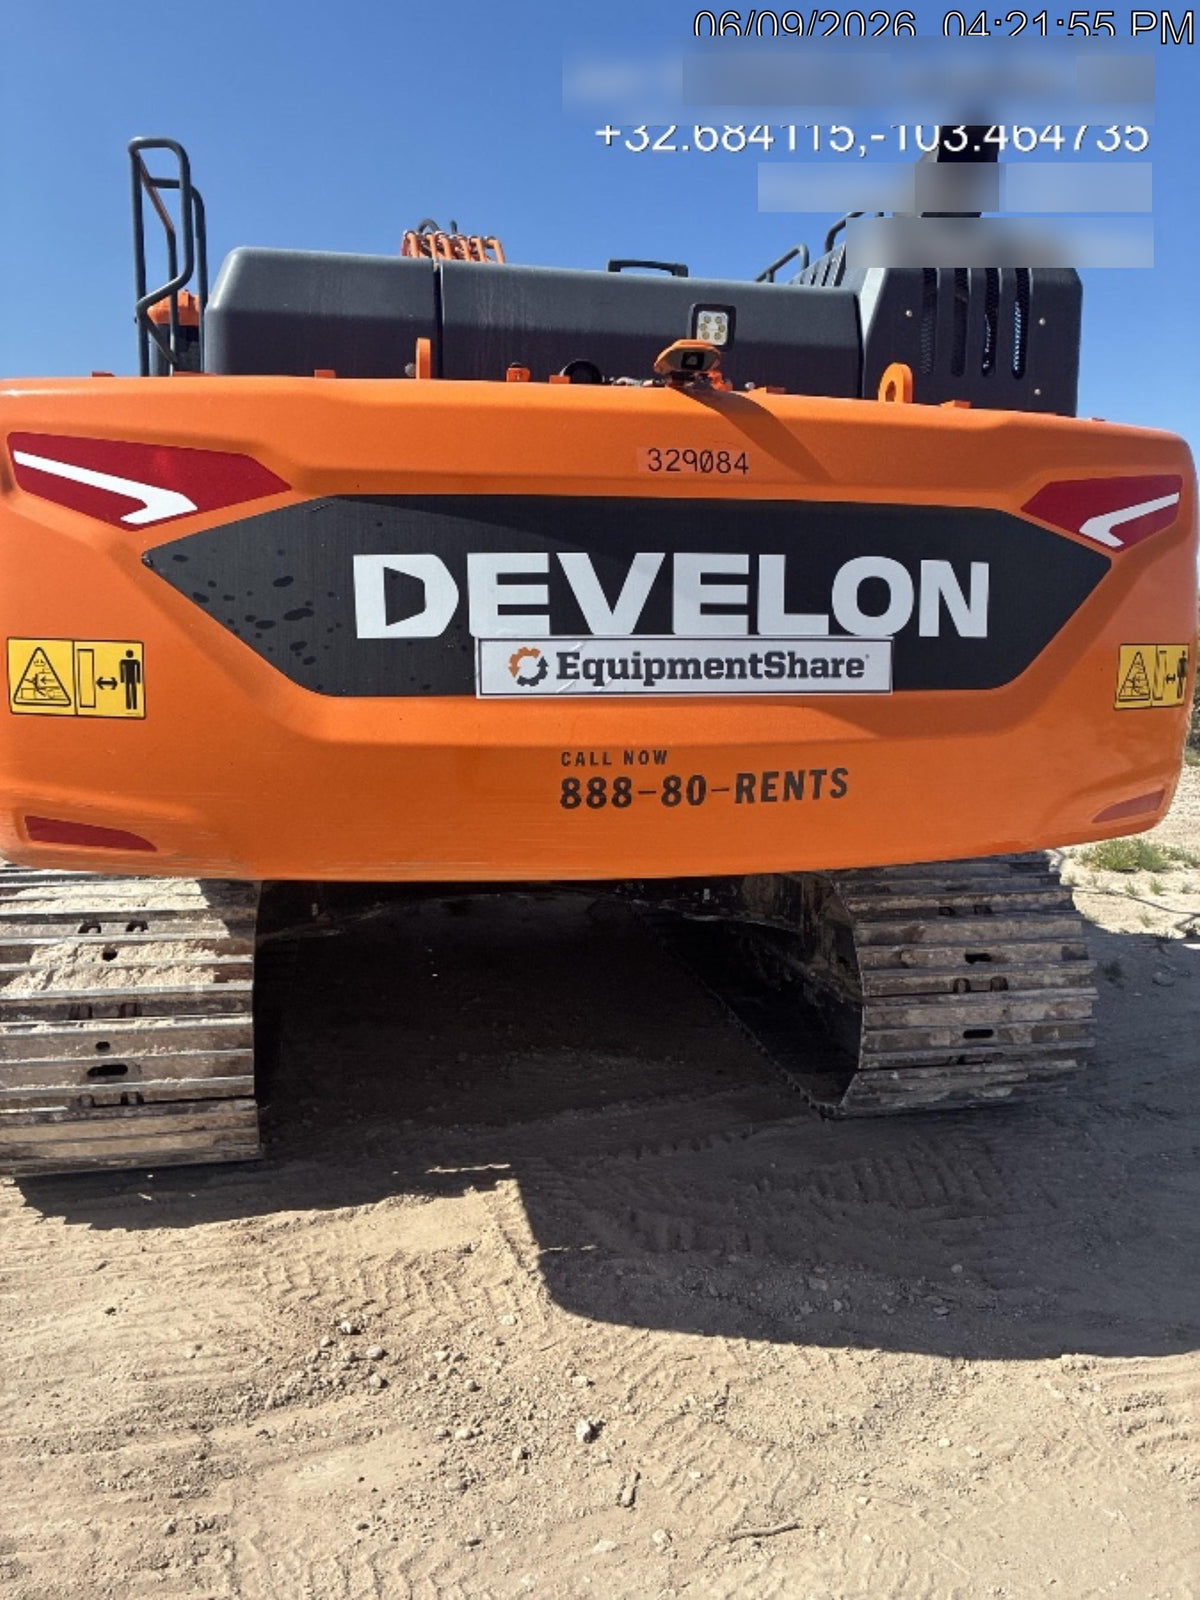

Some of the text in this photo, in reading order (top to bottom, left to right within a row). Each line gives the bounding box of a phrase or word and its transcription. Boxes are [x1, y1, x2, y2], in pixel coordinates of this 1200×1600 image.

[647, 448, 749, 475] 329084
[353, 552, 989, 638] DEVELON
[556, 650, 866, 687] EquipmentShare
[560, 749, 668, 767] CALL NOW
[560, 767, 849, 810] 888-80-RENTS
